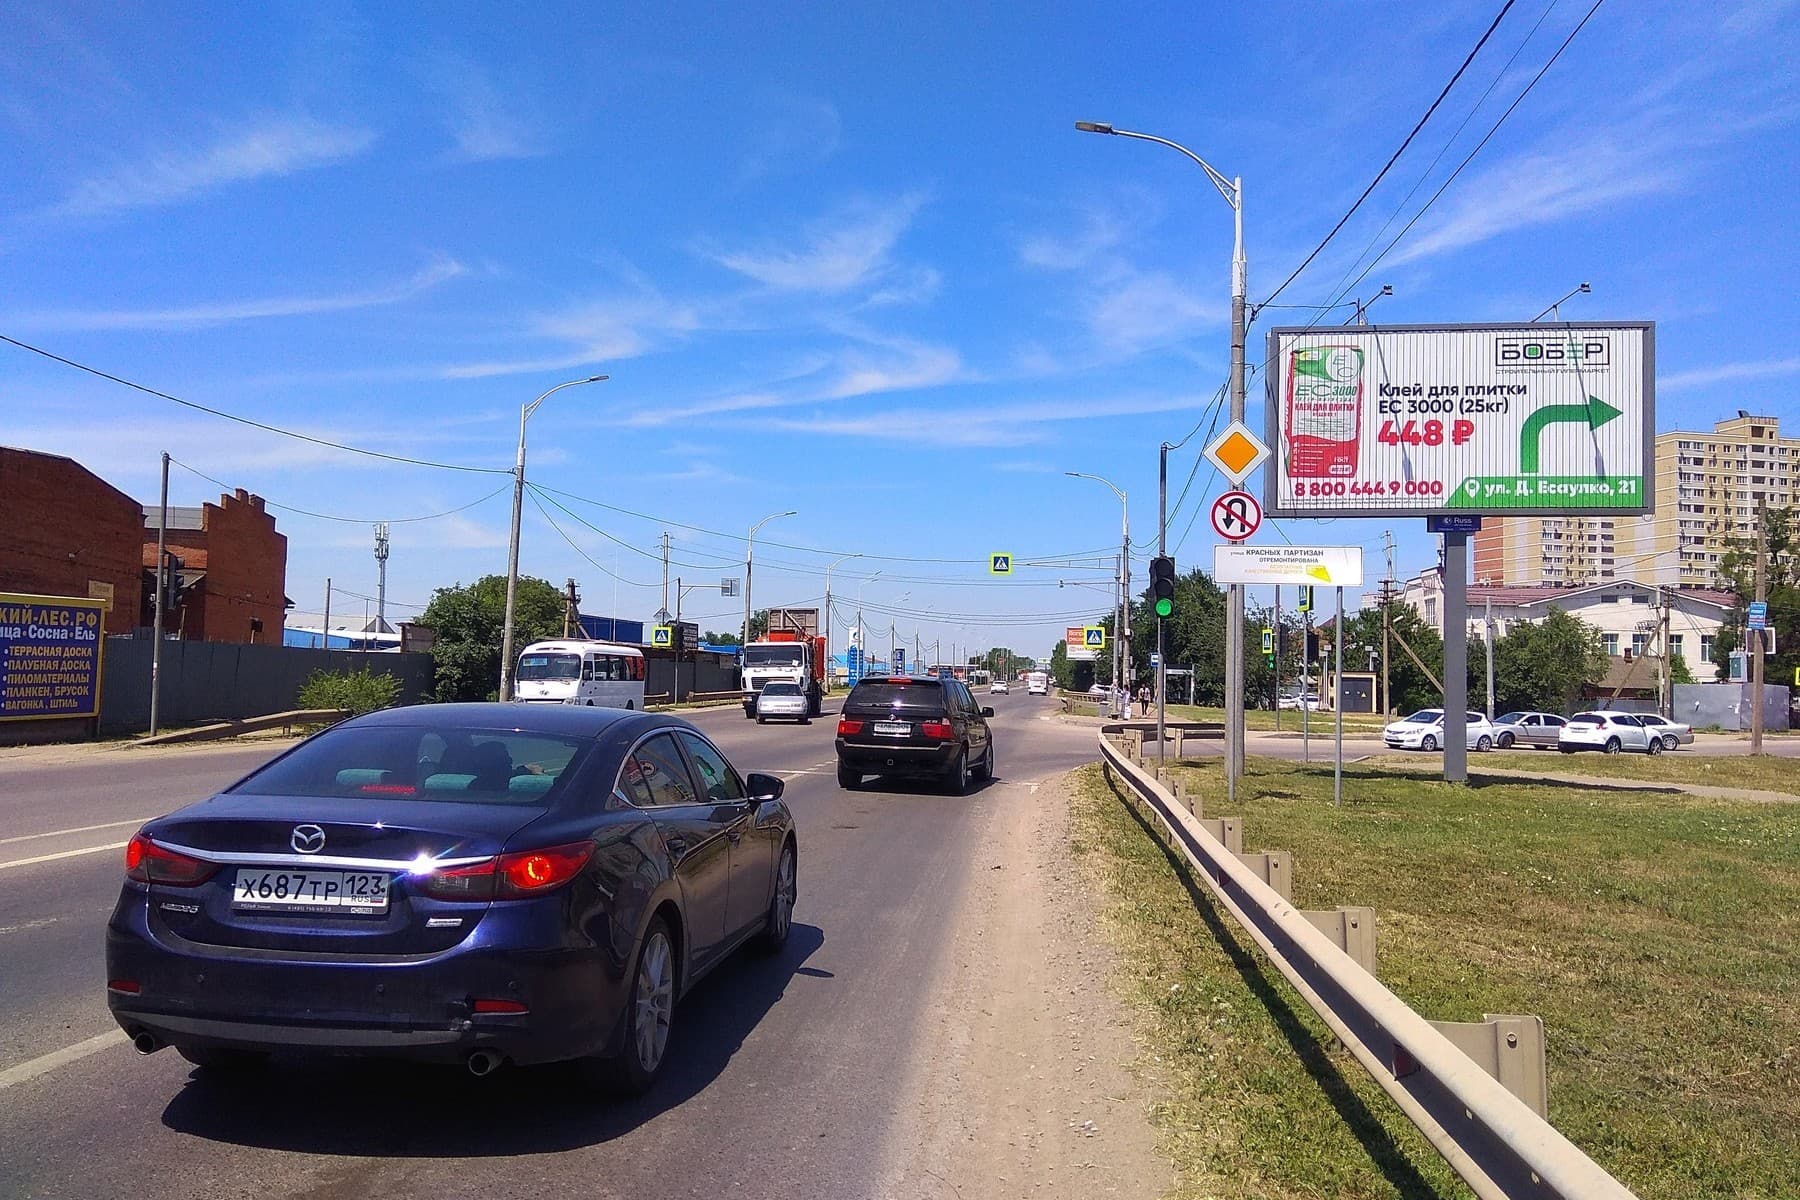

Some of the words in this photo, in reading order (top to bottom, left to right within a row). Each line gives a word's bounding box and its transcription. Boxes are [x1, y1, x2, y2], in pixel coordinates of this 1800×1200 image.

[1332, 385, 1358, 396] 3000
[1379, 383, 1423, 396] Клей
[1428, 384, 1459, 399] для
[1465, 383, 1527, 396] плитки
[1407, 399, 1453, 414] 3000
[1459, 397, 1509, 415] (25кг)
[1378, 419, 1443, 446] 448
[1295, 482, 1305, 496] 8
[1310, 481, 1346, 496] 800
[1350, 481, 1385, 495] 444
[1389, 480, 1401, 495] 9
[1405, 480, 1443, 495] 000
[1484, 482, 1511, 496] ул.
[1515, 480, 1534, 497] Д.
[1538, 480, 1615, 496] Есаулко,
[1618, 480, 1636, 494] 21
[28, 624, 68, 640] Сосна
[75, 626, 96, 640] Ель
[9, 646, 62, 657] ТЕРРАСНАЯ
[63, 647, 92, 658] ДОСКА
[8, 660, 59, 670] ПАЛУБНАЯ
[60, 660, 91, 672] ДОСКА
[7, 673, 90, 684] ПИЛОМАТЕРИАЛЫ
[6, 687, 53, 698] ПЛАНКЕН,
[54, 686, 89, 696] БРУСОК
[50, 699, 78, 708] ШТИЛЬ
[346, 875, 383, 895] 123
